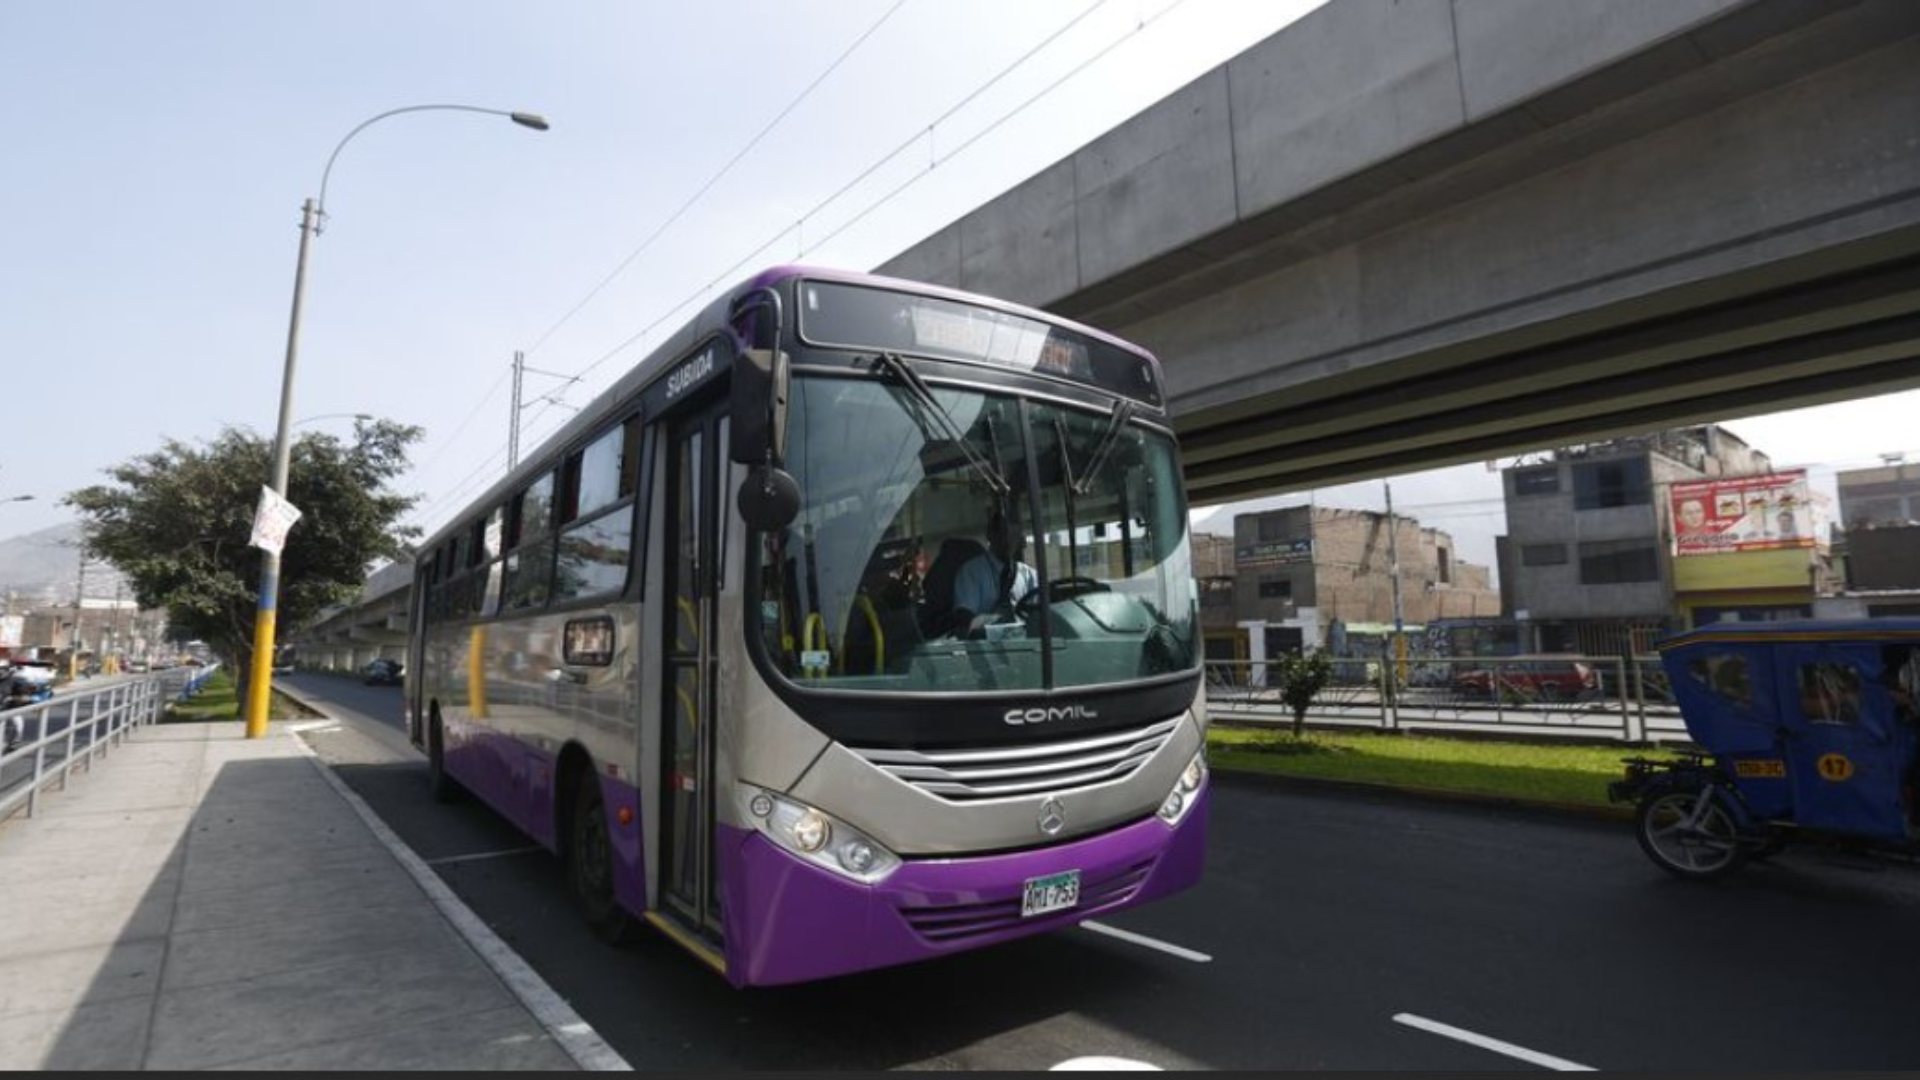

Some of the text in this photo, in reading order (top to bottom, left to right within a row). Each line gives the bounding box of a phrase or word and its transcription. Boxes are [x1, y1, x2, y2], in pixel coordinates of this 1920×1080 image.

[665, 349, 714, 399] SUBIDA
[1004, 705, 1098, 725] COMIL
[1823, 756, 1847, 777] 17
